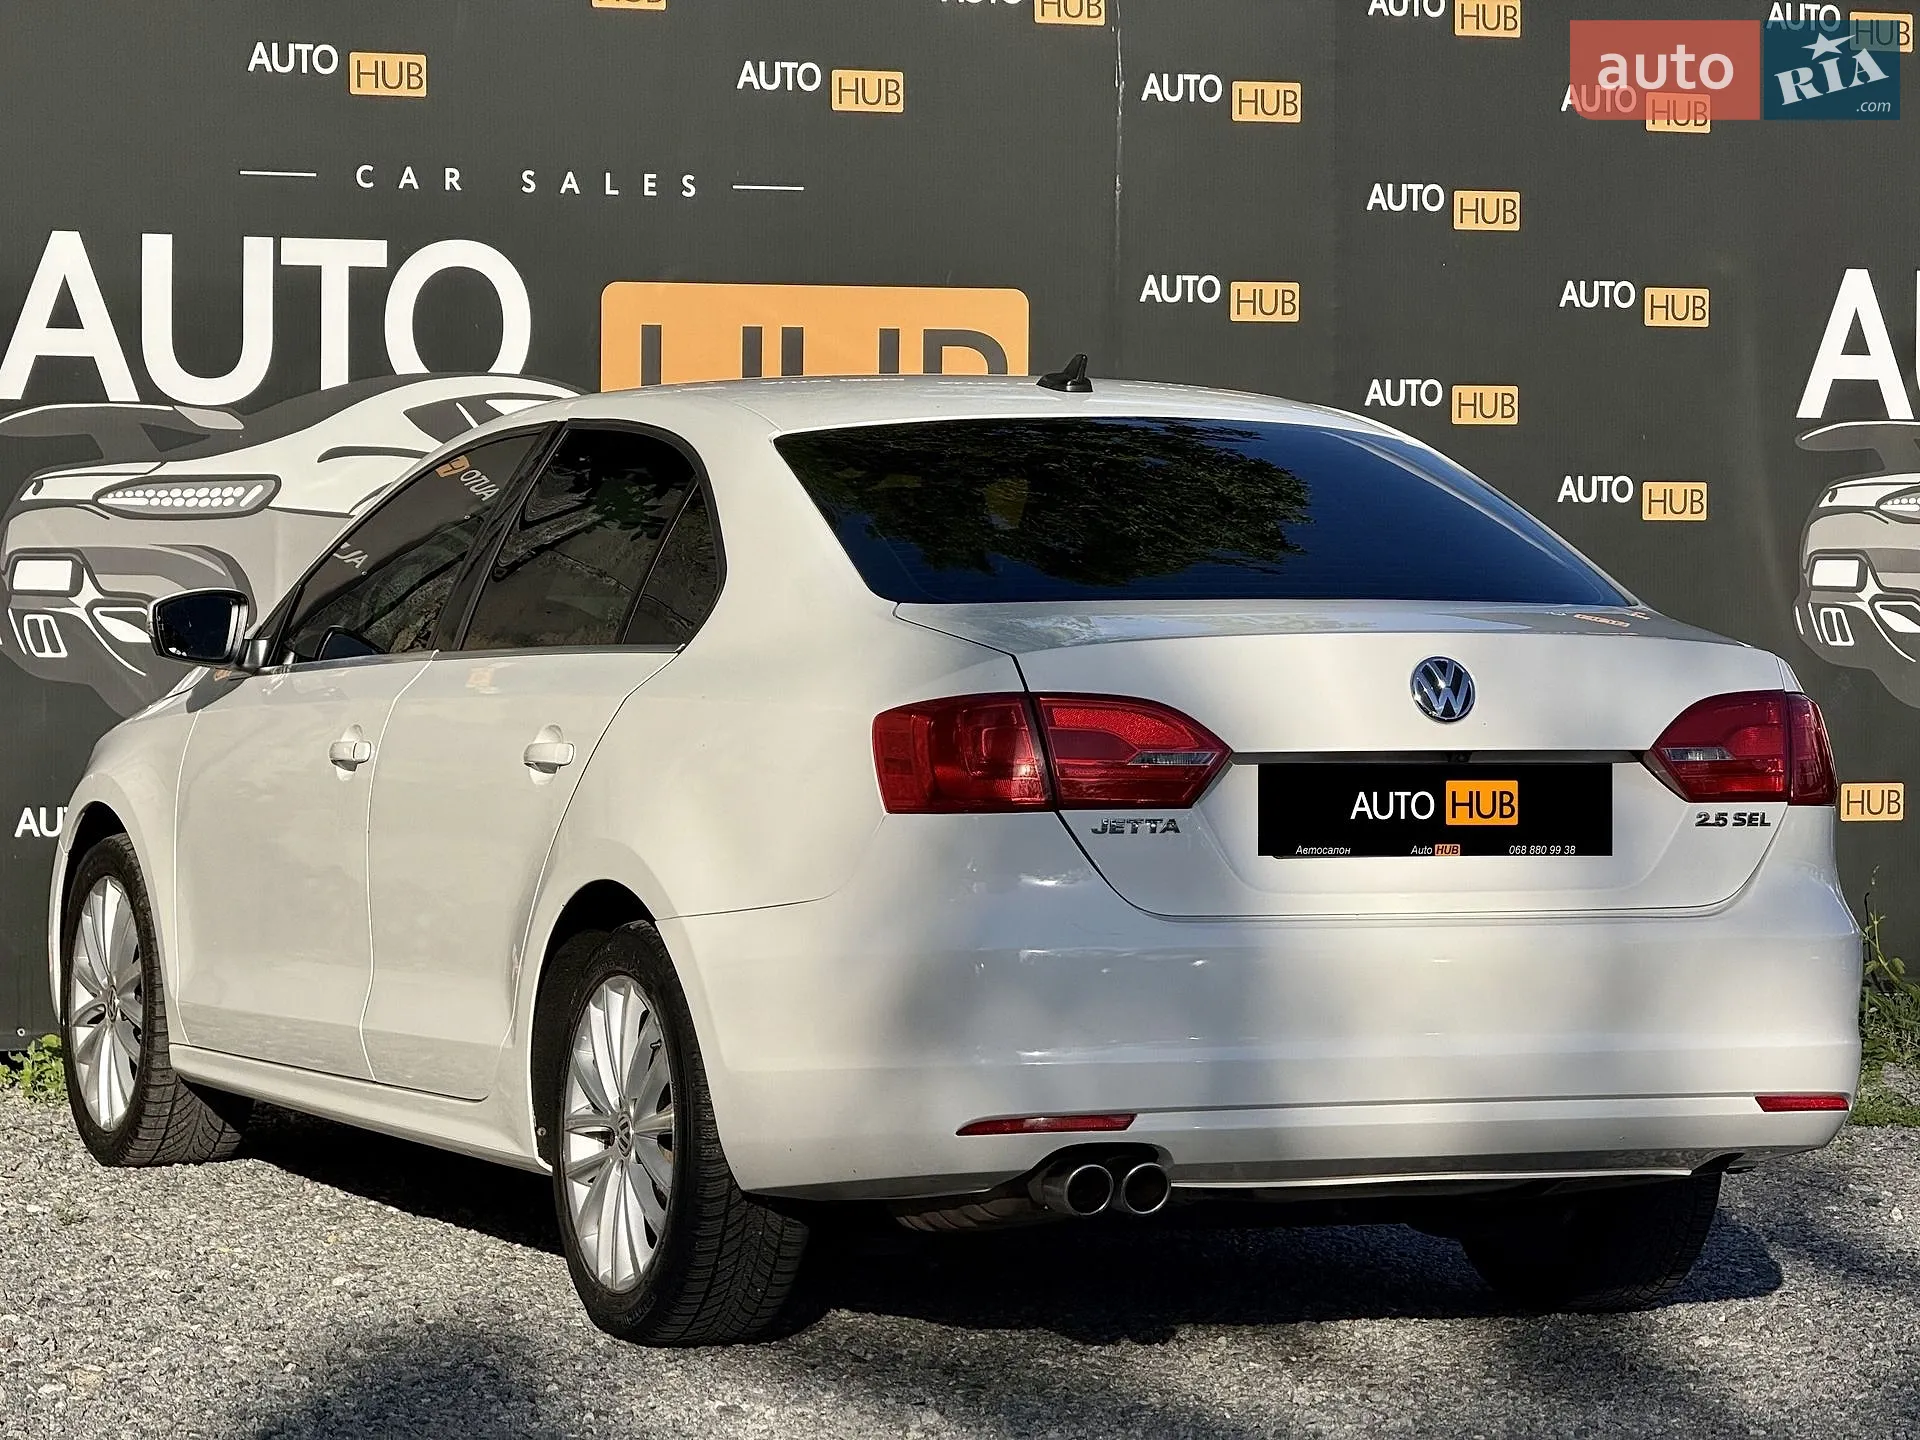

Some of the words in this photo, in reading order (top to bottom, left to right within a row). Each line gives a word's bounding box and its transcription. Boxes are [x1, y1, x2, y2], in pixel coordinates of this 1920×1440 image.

[1041, 0, 1102, 18] HUB
[1368, 0, 1446, 17] AUTO
[1460, 3, 1518, 31] HUB
[1766, 1, 1842, 32] AUTO
[1855, 18, 1910, 46] HUB
[248, 41, 339, 75] AUTO
[356, 59, 424, 90] HUB
[737, 60, 822, 91] AUTO
[838, 76, 901, 106] HUB
[1141, 73, 1223, 103] AUTO
[1238, 88, 1298, 117] HUB
[1651, 98, 1708, 127] HUB
[355, 164, 462, 191] CAR
[521, 169, 696, 198] SALES
[1367, 183, 1445, 212] AUTO
[1459, 197, 1518, 225] HUB
[1140, 274, 1221, 303] AUTO
[1236, 288, 1297, 316] HUB
[1559, 280, 1636, 309] AUTO
[1650, 294, 1707, 321] HUB
[0, 230, 532, 405] AUTO
[1795, 268, 1920, 419] A
[1365, 378, 1443, 407] AUTO
[1458, 391, 1516, 419] HUB
[1557, 475, 1634, 503] AUTO
[1648, 488, 1705, 515] HUB
[1732, 811, 1772, 828] SEL
[1846, 789, 1902, 816] HUB
[1091, 818, 1181, 835] JETTA
